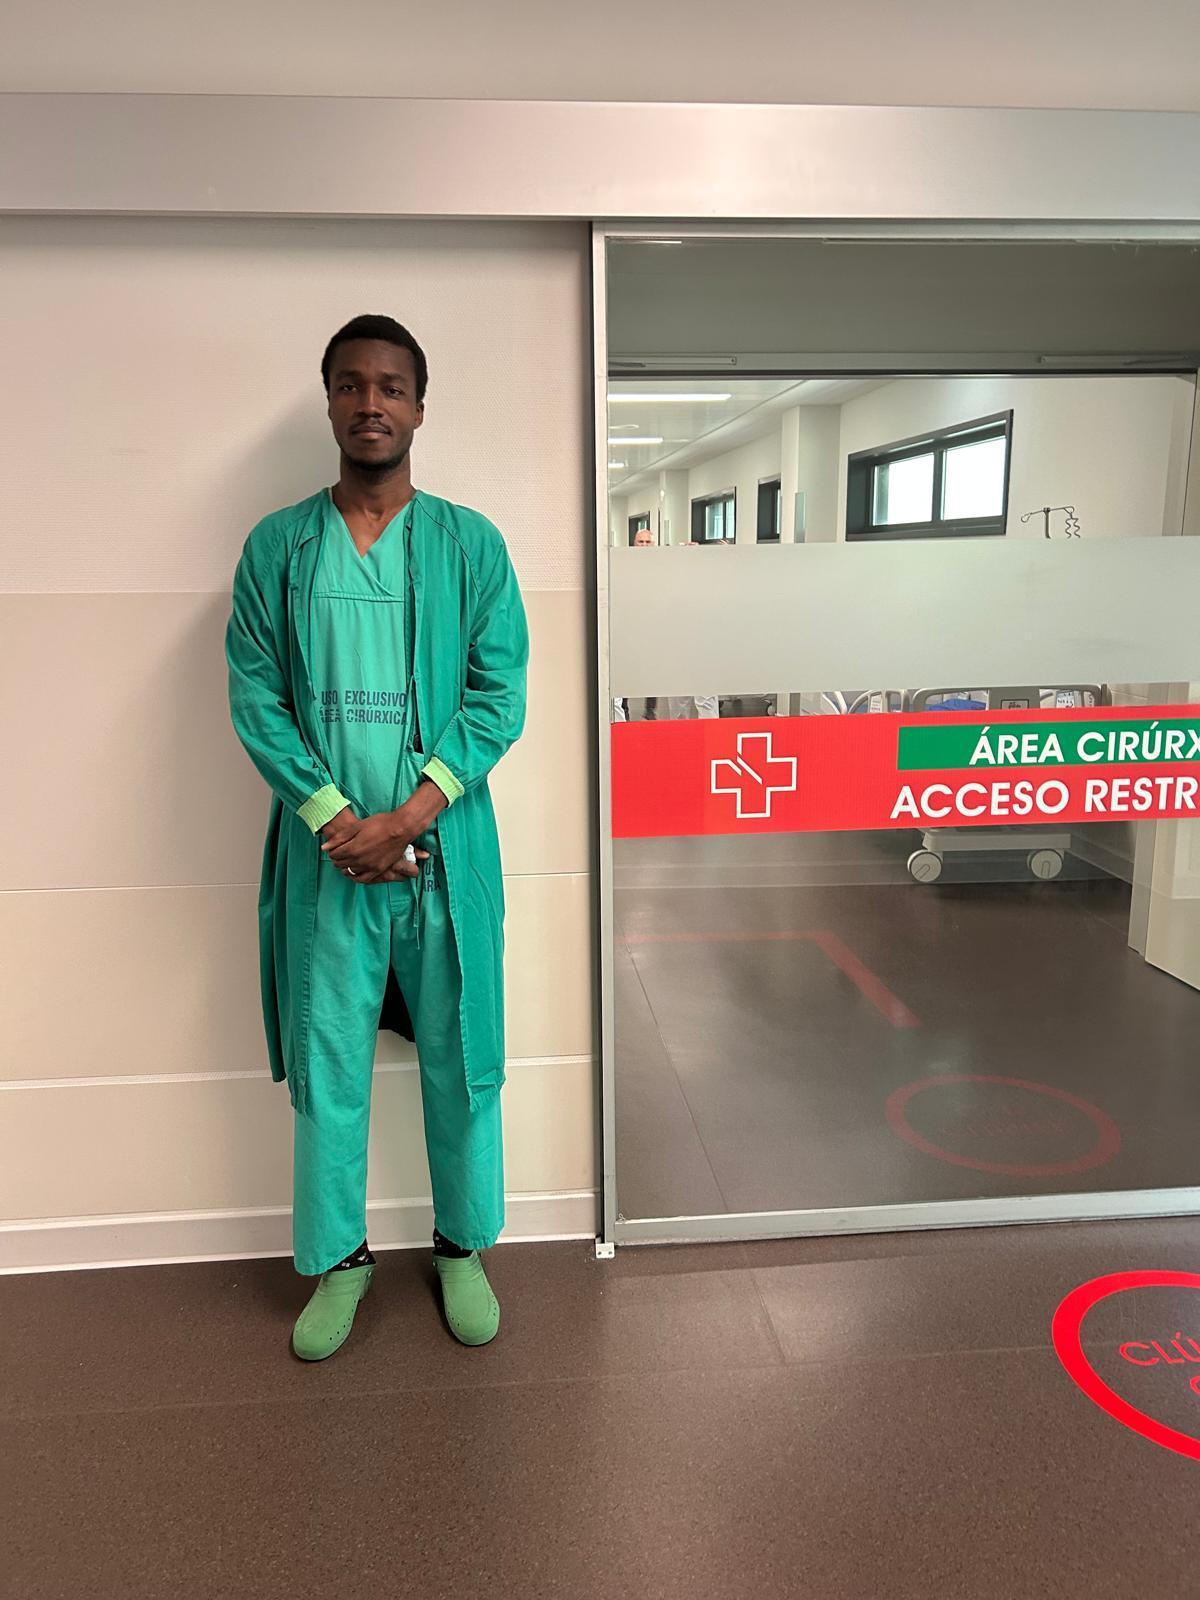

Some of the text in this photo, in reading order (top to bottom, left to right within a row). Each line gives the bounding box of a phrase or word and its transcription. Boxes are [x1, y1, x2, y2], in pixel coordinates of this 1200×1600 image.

[321, 690, 407, 707] USO EXCLUSIVO
[346, 706, 408, 725] CIRÚRXICA
[969, 726, 1065, 765] ÁREA
[890, 776, 1199, 819] ACCESO RESTR
